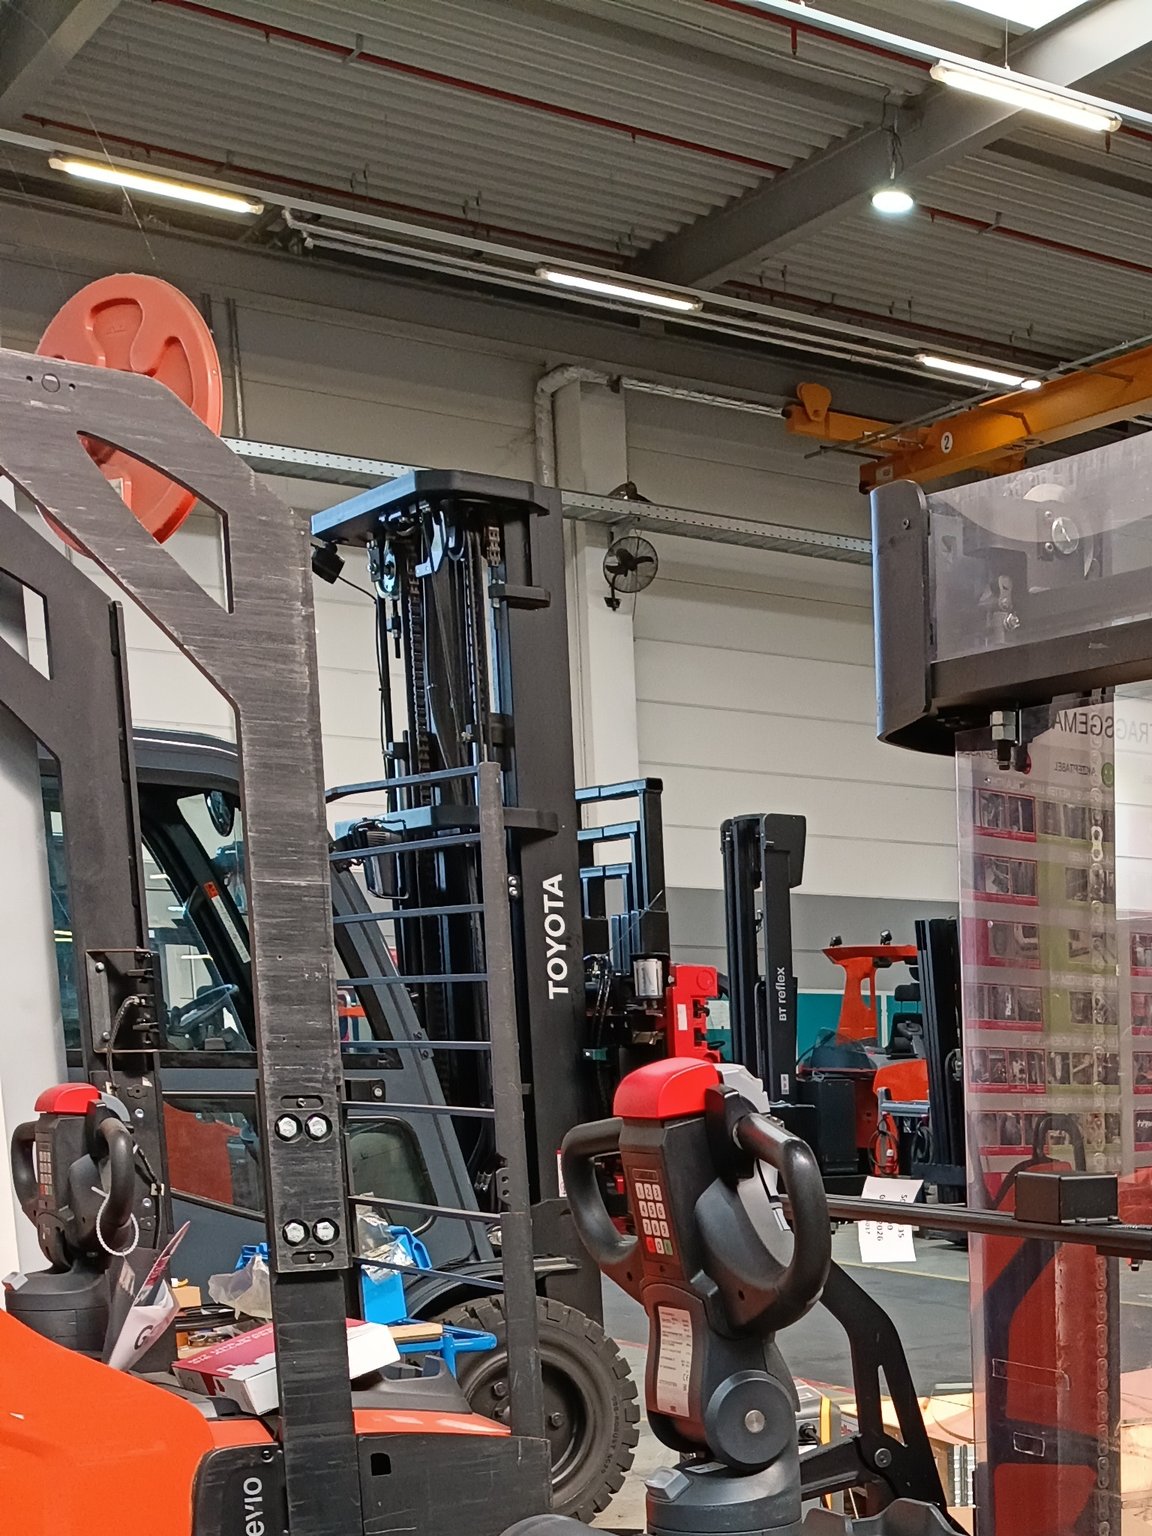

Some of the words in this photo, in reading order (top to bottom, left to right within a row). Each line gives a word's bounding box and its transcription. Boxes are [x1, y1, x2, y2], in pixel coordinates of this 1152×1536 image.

[943, 434, 951, 451] 2
[543, 873, 569, 1000] TOYOTA
[775, 966, 786, 1004] reflex
[778, 1006, 787, 1021] BT
